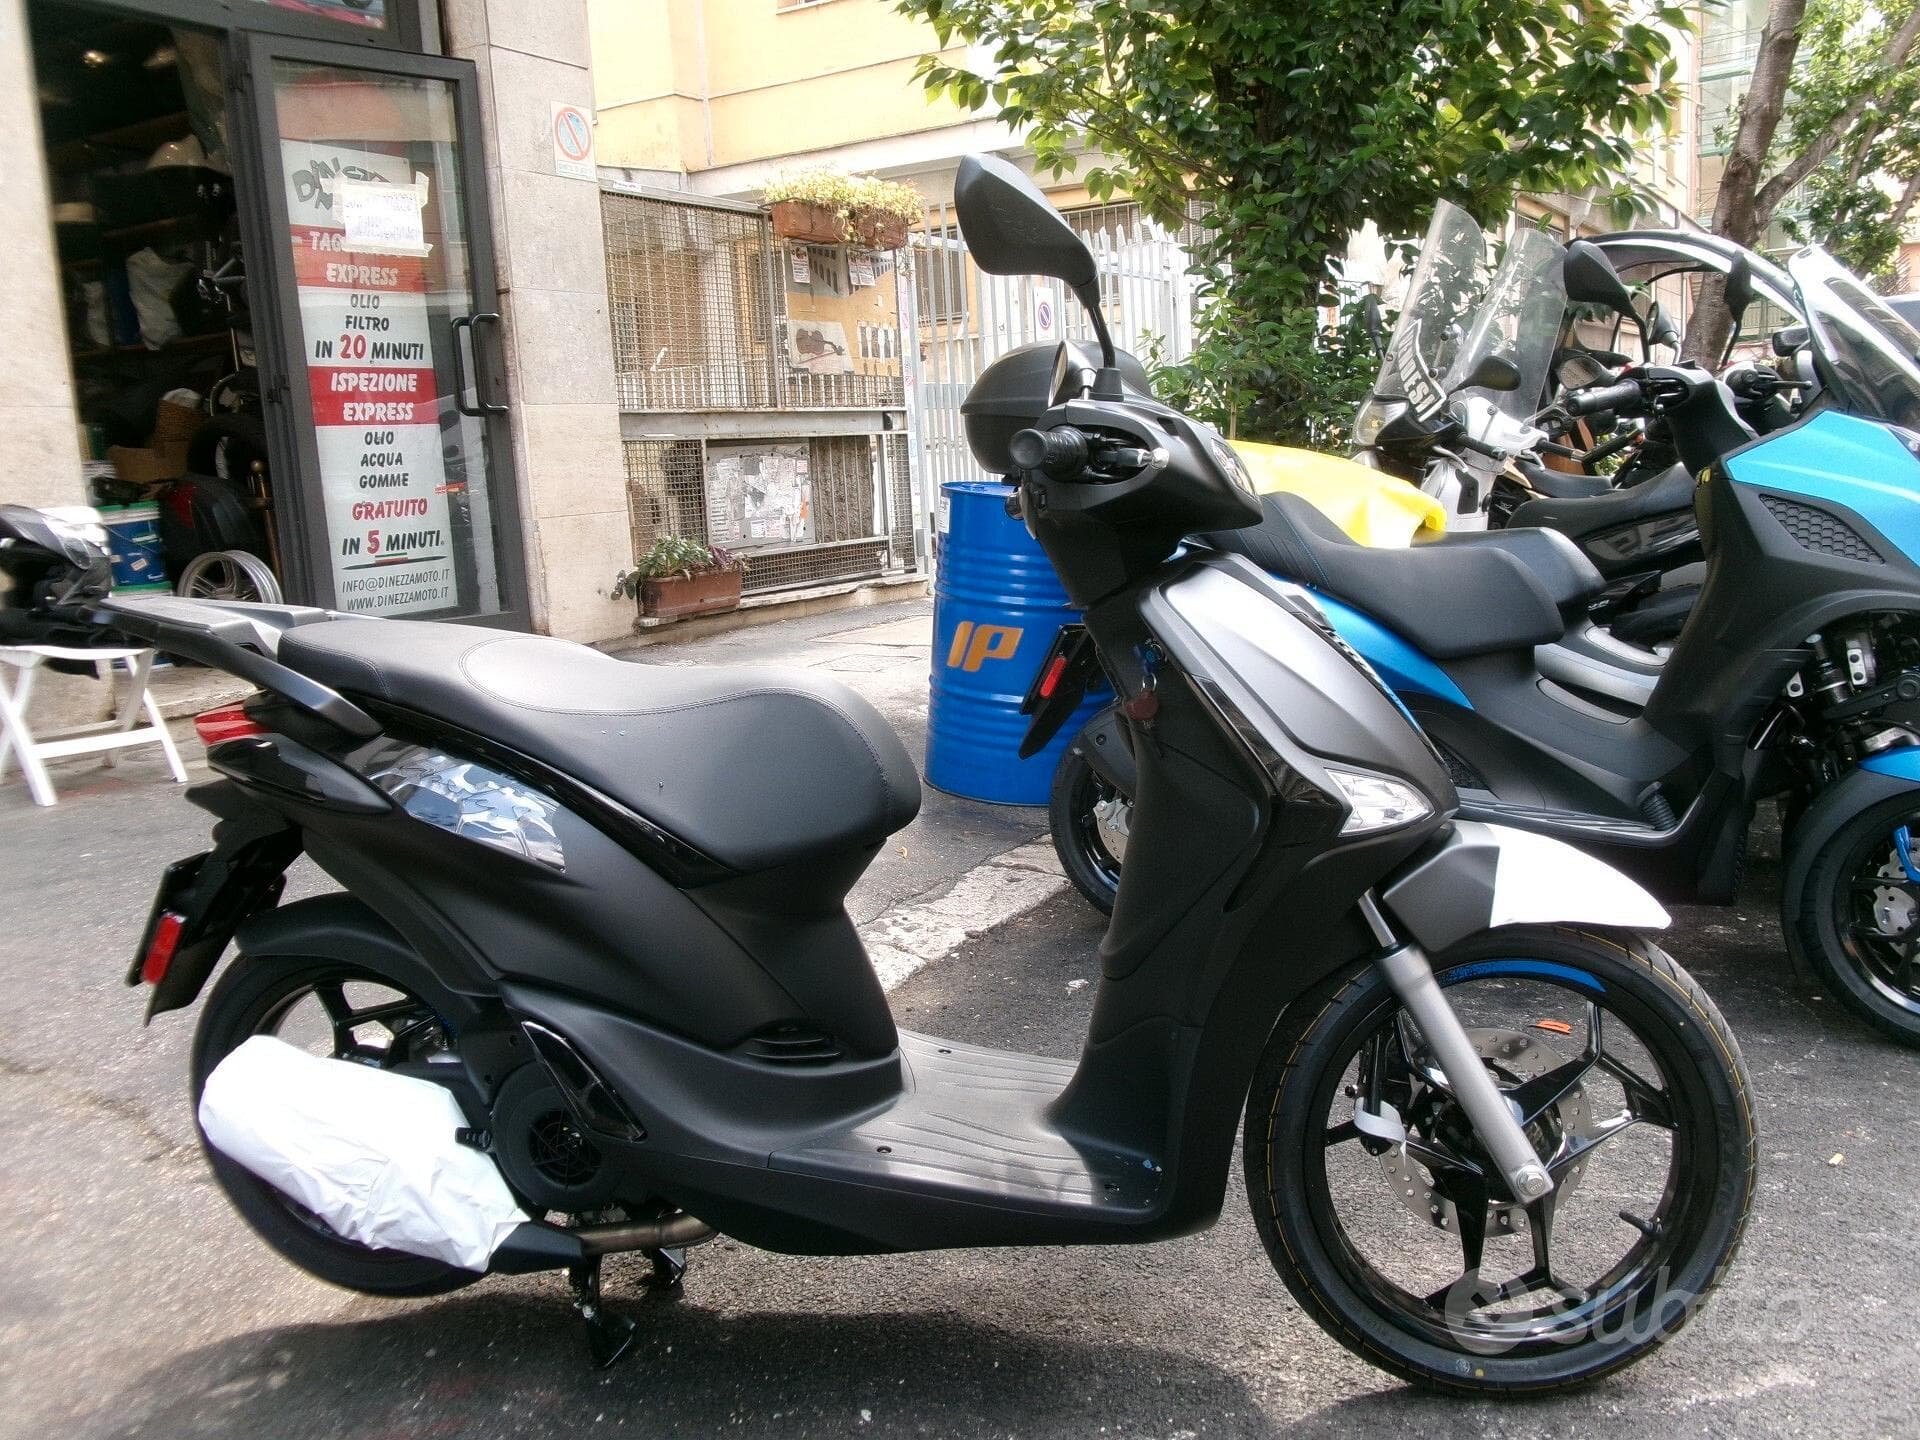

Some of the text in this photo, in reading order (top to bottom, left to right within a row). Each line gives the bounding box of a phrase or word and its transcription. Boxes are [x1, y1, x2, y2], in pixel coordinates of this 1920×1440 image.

[326, 262, 400, 286] EXPRESS
[350, 293, 380, 310] OLIO
[345, 314, 389, 331] FILTRO
[315, 333, 424, 360] IN 20 MINUTI
[330, 372, 417, 392] ISPEZIONE
[342, 402, 414, 421] EXPRESS
[364, 431, 394, 446] OLIO
[360, 451, 403, 468] ACQUA
[359, 472, 409, 489] GOMME
[351, 497, 428, 521] GRATUITO
[341, 537, 361, 556] IN
[366, 529, 380, 555] 5
[342, 568, 451, 594] INFO@DINEZZAMOTO.IT
[347, 586, 449, 611] WWW.DINEZZAMOTO.IT
[946, 620, 1024, 673] IP
